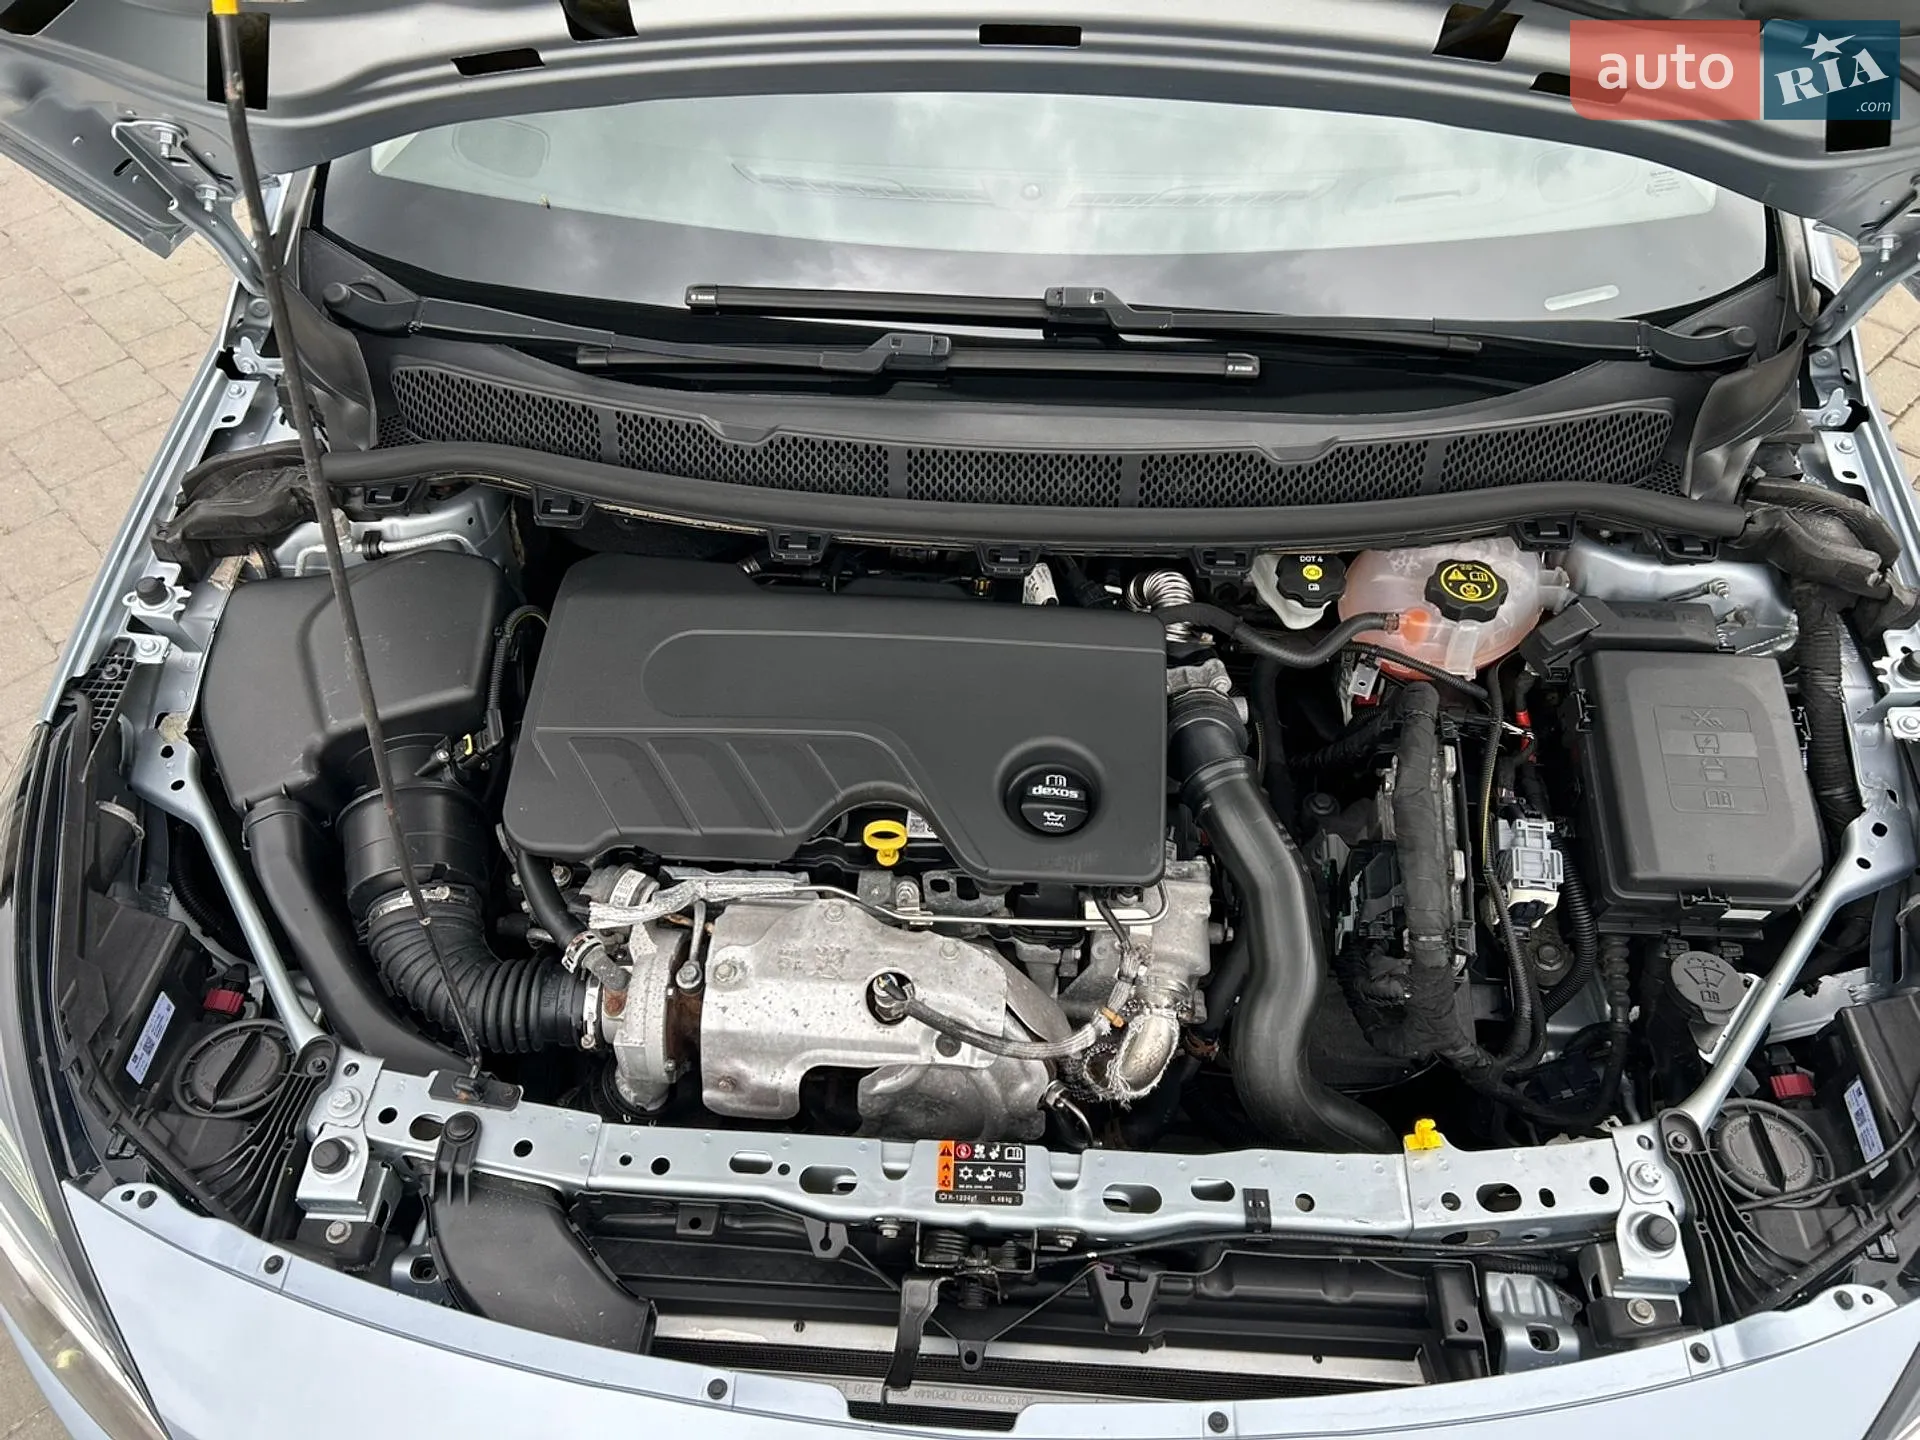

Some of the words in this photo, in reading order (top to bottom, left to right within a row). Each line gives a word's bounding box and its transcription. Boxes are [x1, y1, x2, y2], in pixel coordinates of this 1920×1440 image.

[1299, 555, 1316, 563] DOT
[1317, 555, 1324, 563] 4
[1031, 784, 1079, 799] dexos
[998, 1171, 1013, 1179] PAG
